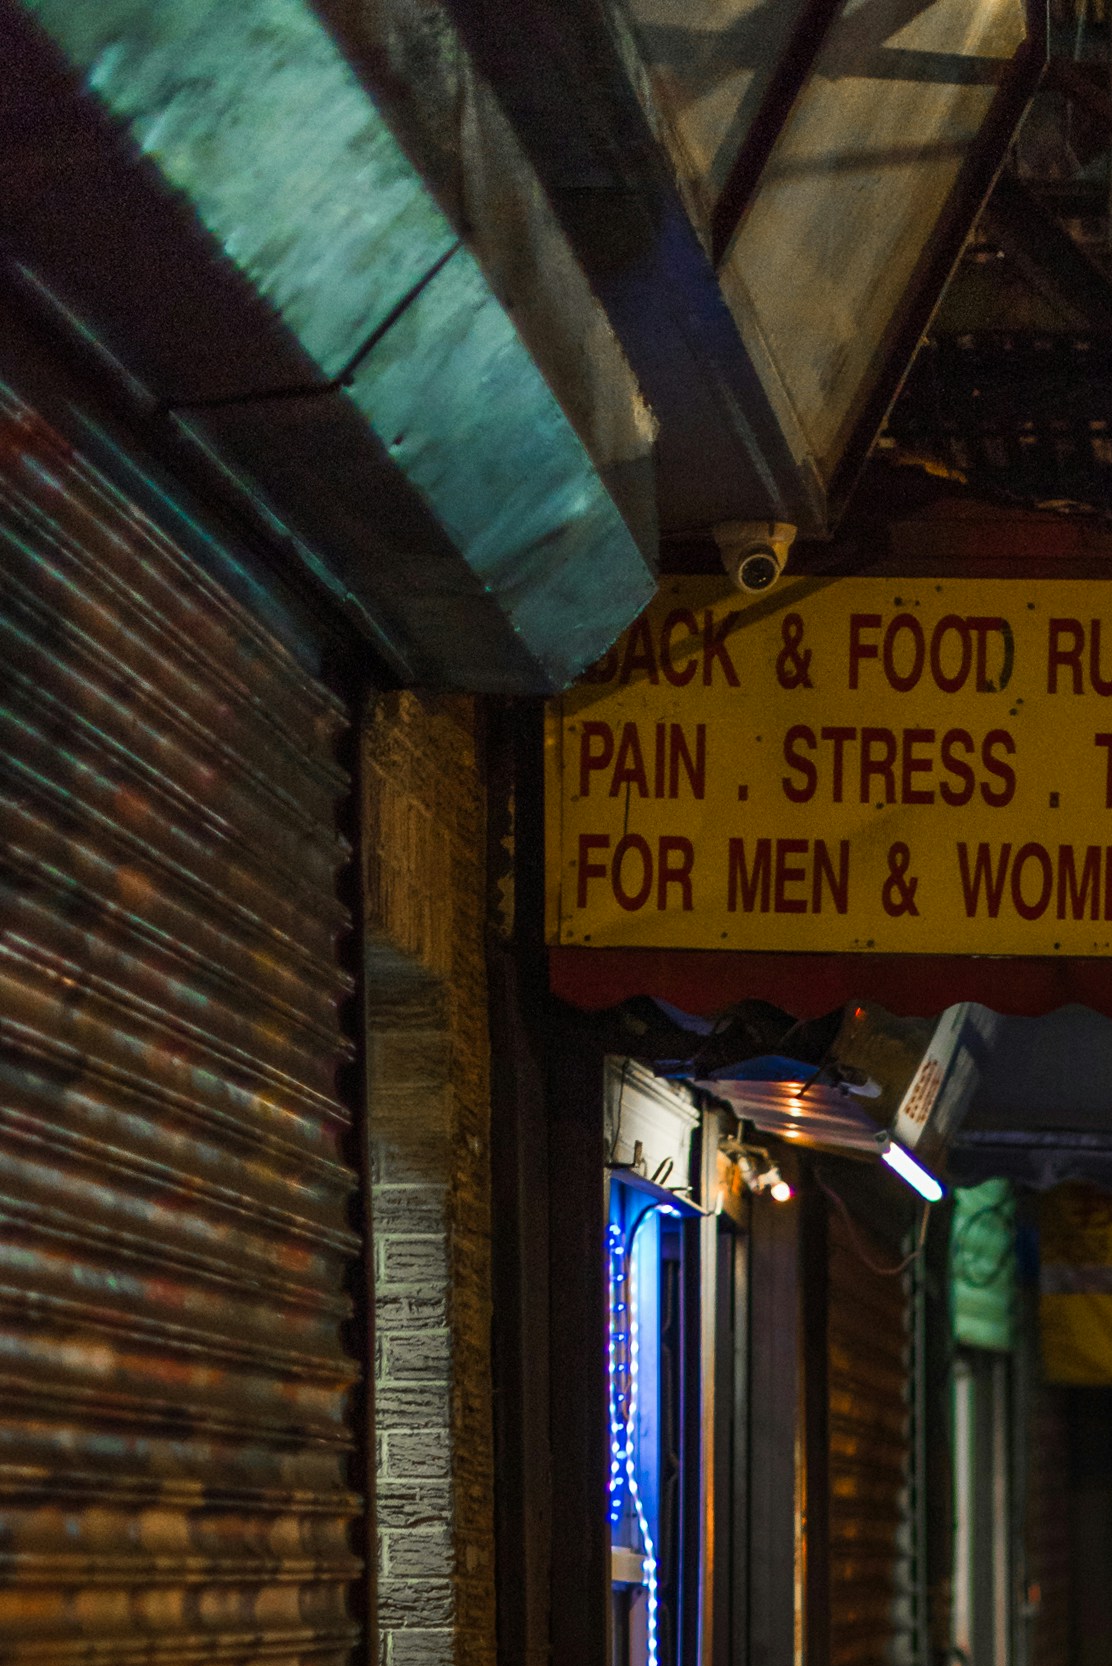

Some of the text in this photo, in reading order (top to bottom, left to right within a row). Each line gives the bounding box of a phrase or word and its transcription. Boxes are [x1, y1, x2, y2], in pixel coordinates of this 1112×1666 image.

[776, 613, 813, 690] &
[579, 720, 707, 801] PAIN
[782, 724, 1017, 807] STRESS
[577, 834, 696, 912] FOR
[727, 837, 850, 915] MEN
[882, 841, 920, 917] &
